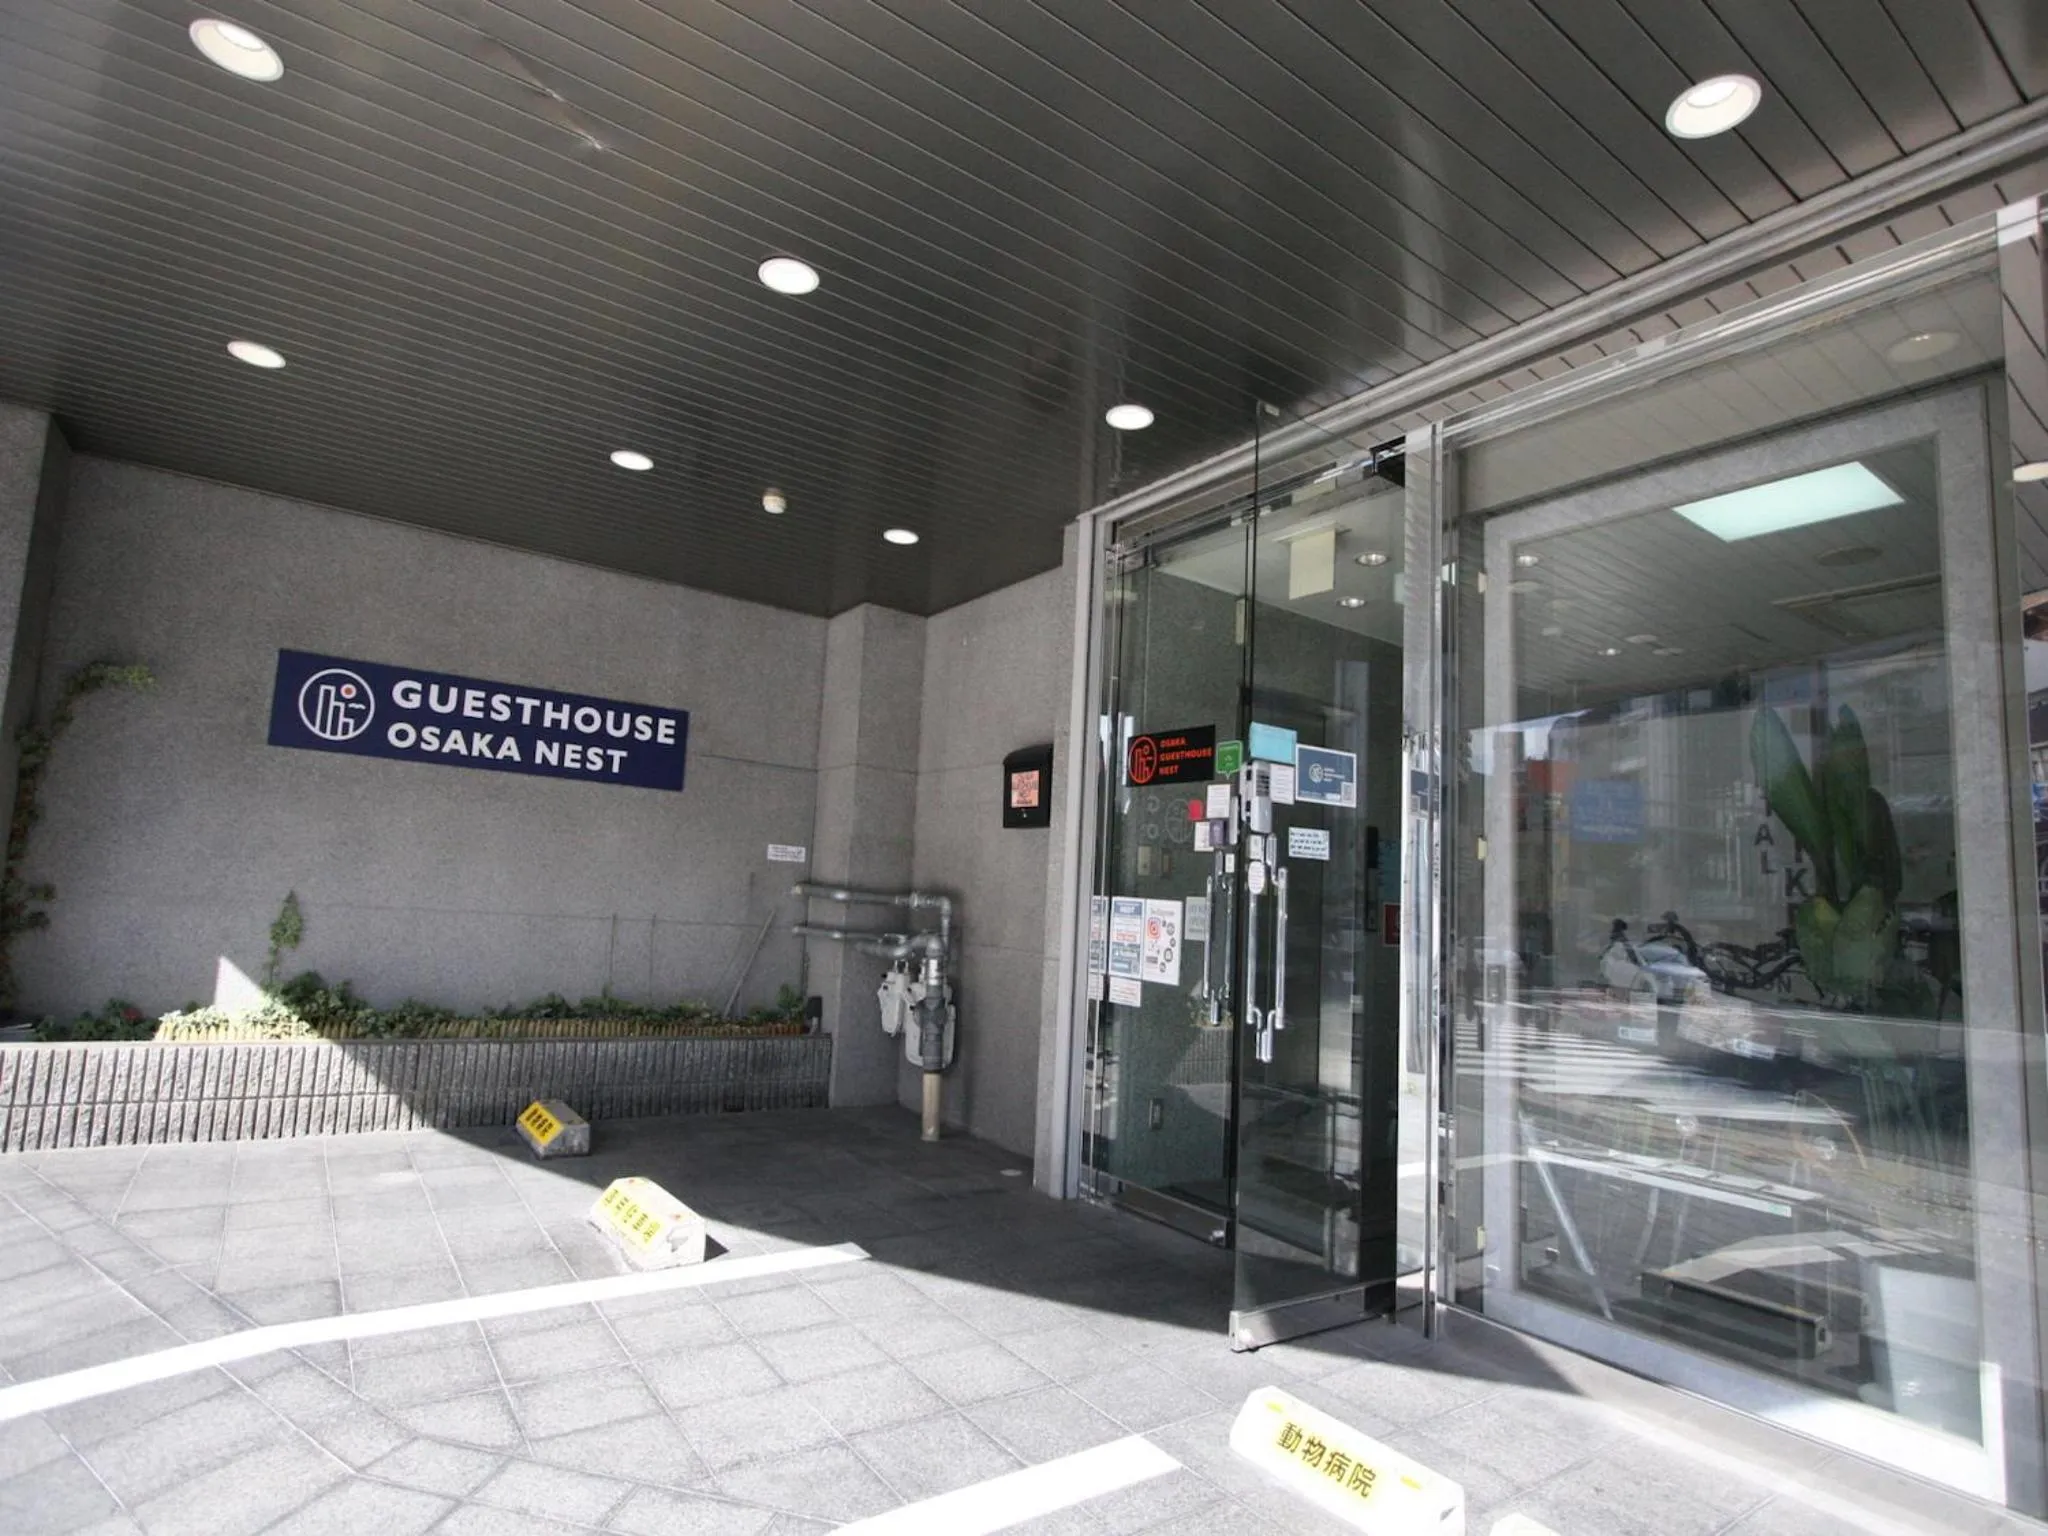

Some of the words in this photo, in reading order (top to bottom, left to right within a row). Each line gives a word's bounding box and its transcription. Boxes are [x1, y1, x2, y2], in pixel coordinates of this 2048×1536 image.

[392, 680, 676, 745] GUESTHOUSE
[387, 722, 522, 762] OSAKA
[535, 741, 628, 774] NEST
[1276, 1421, 1377, 1498] 動物病院
